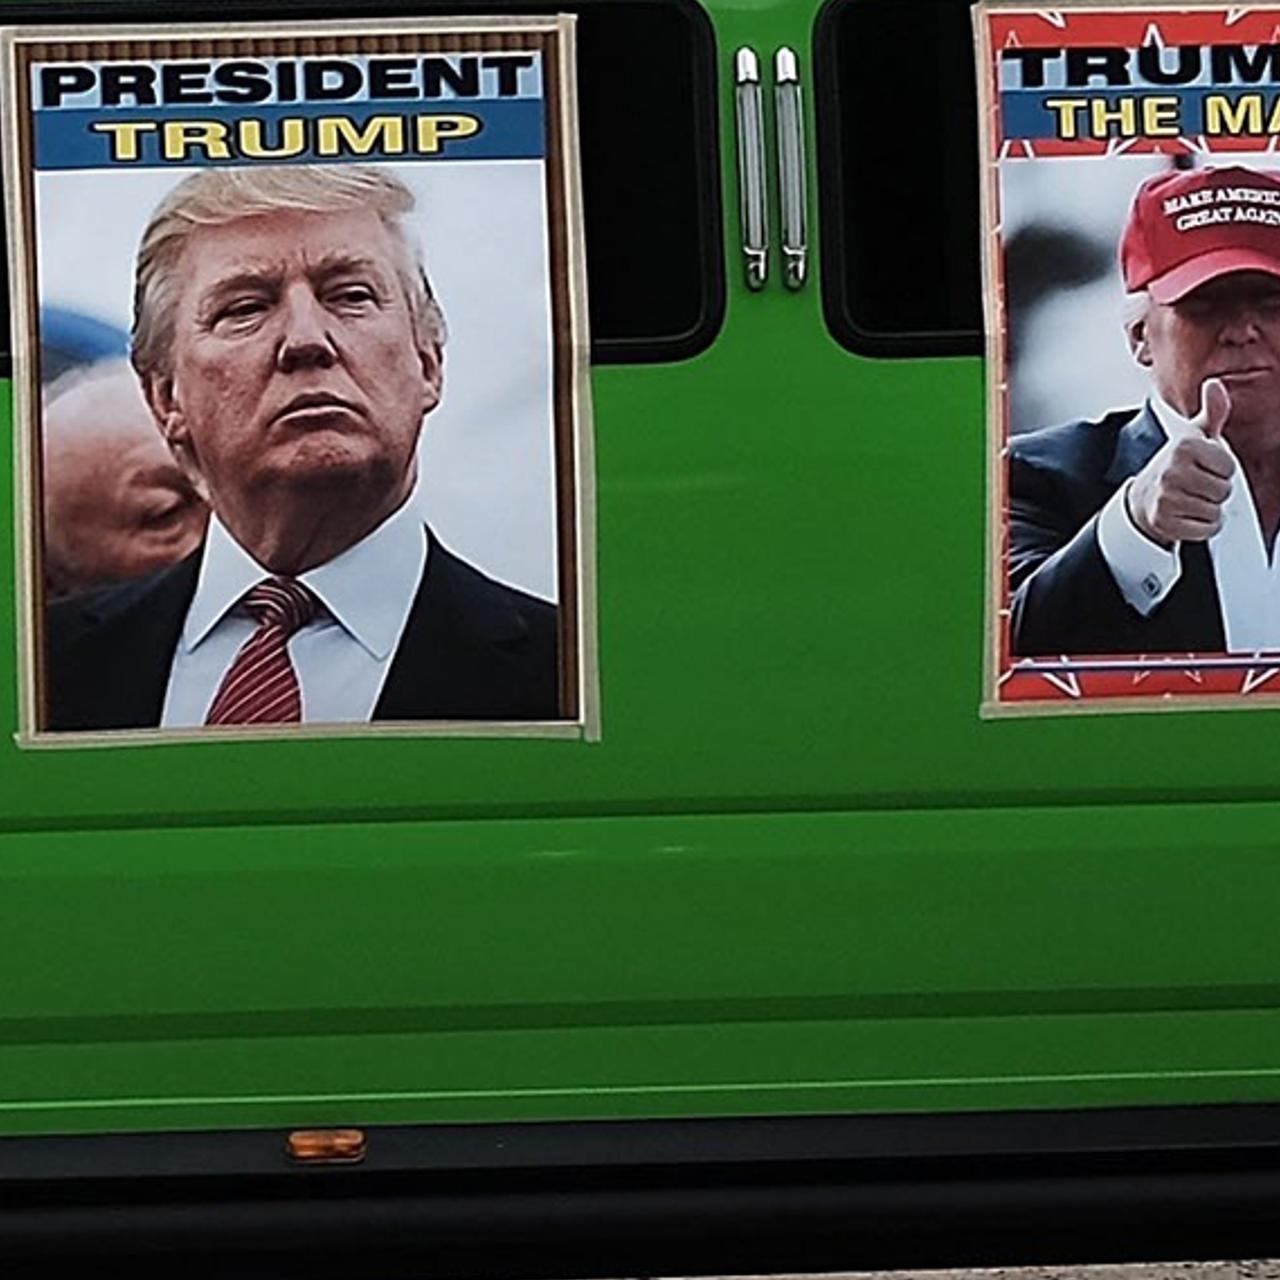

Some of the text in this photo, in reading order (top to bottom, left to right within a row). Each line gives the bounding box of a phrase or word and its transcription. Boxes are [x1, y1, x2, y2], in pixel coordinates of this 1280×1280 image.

[40, 56, 534, 107] PRESIDENT
[93, 114, 479, 160] TRUMP
[1047, 96, 1179, 138] THE
[1163, 189, 1213, 215] MAKE
[1176, 207, 1233, 231] GREAT
